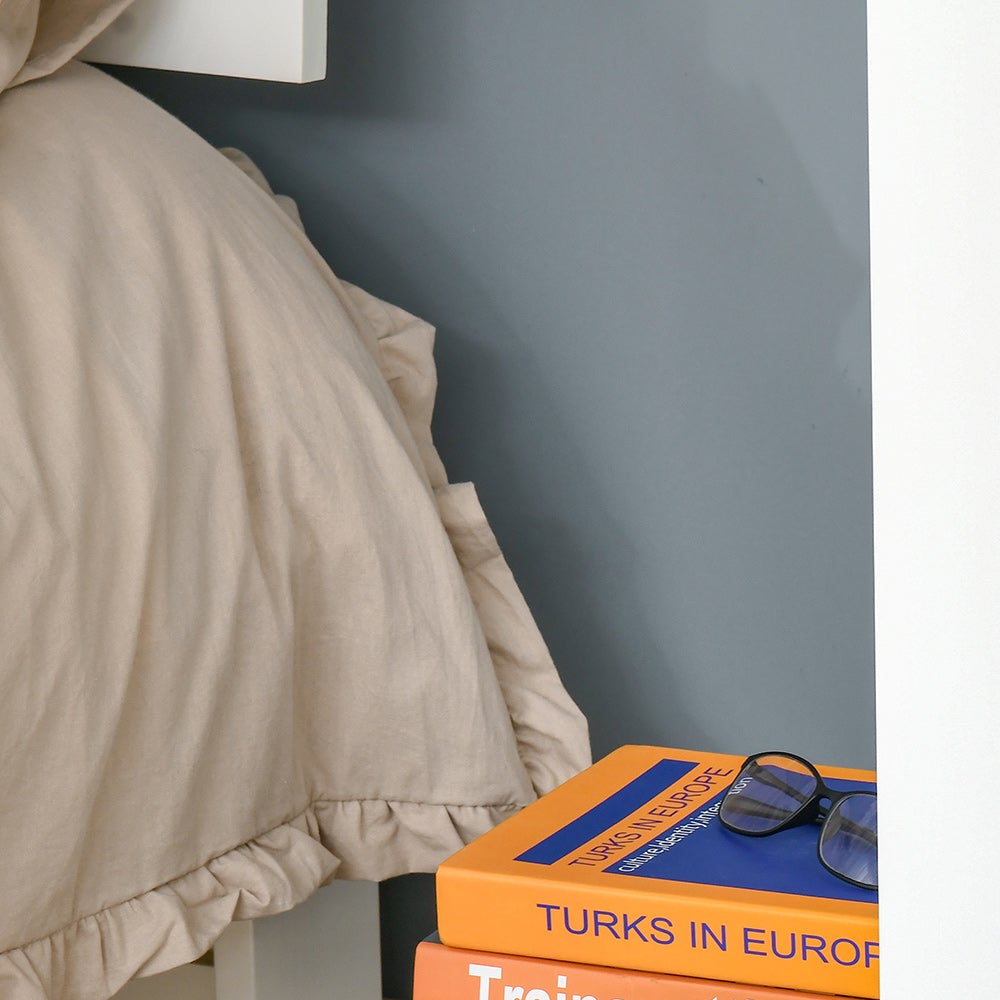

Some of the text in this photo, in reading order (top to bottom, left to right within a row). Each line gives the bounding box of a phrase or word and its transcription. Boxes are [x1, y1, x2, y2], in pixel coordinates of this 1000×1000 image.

[568, 767, 734, 867] TURKS IN EUROPE
[536, 903, 880, 968] TURKS IN EUROP
